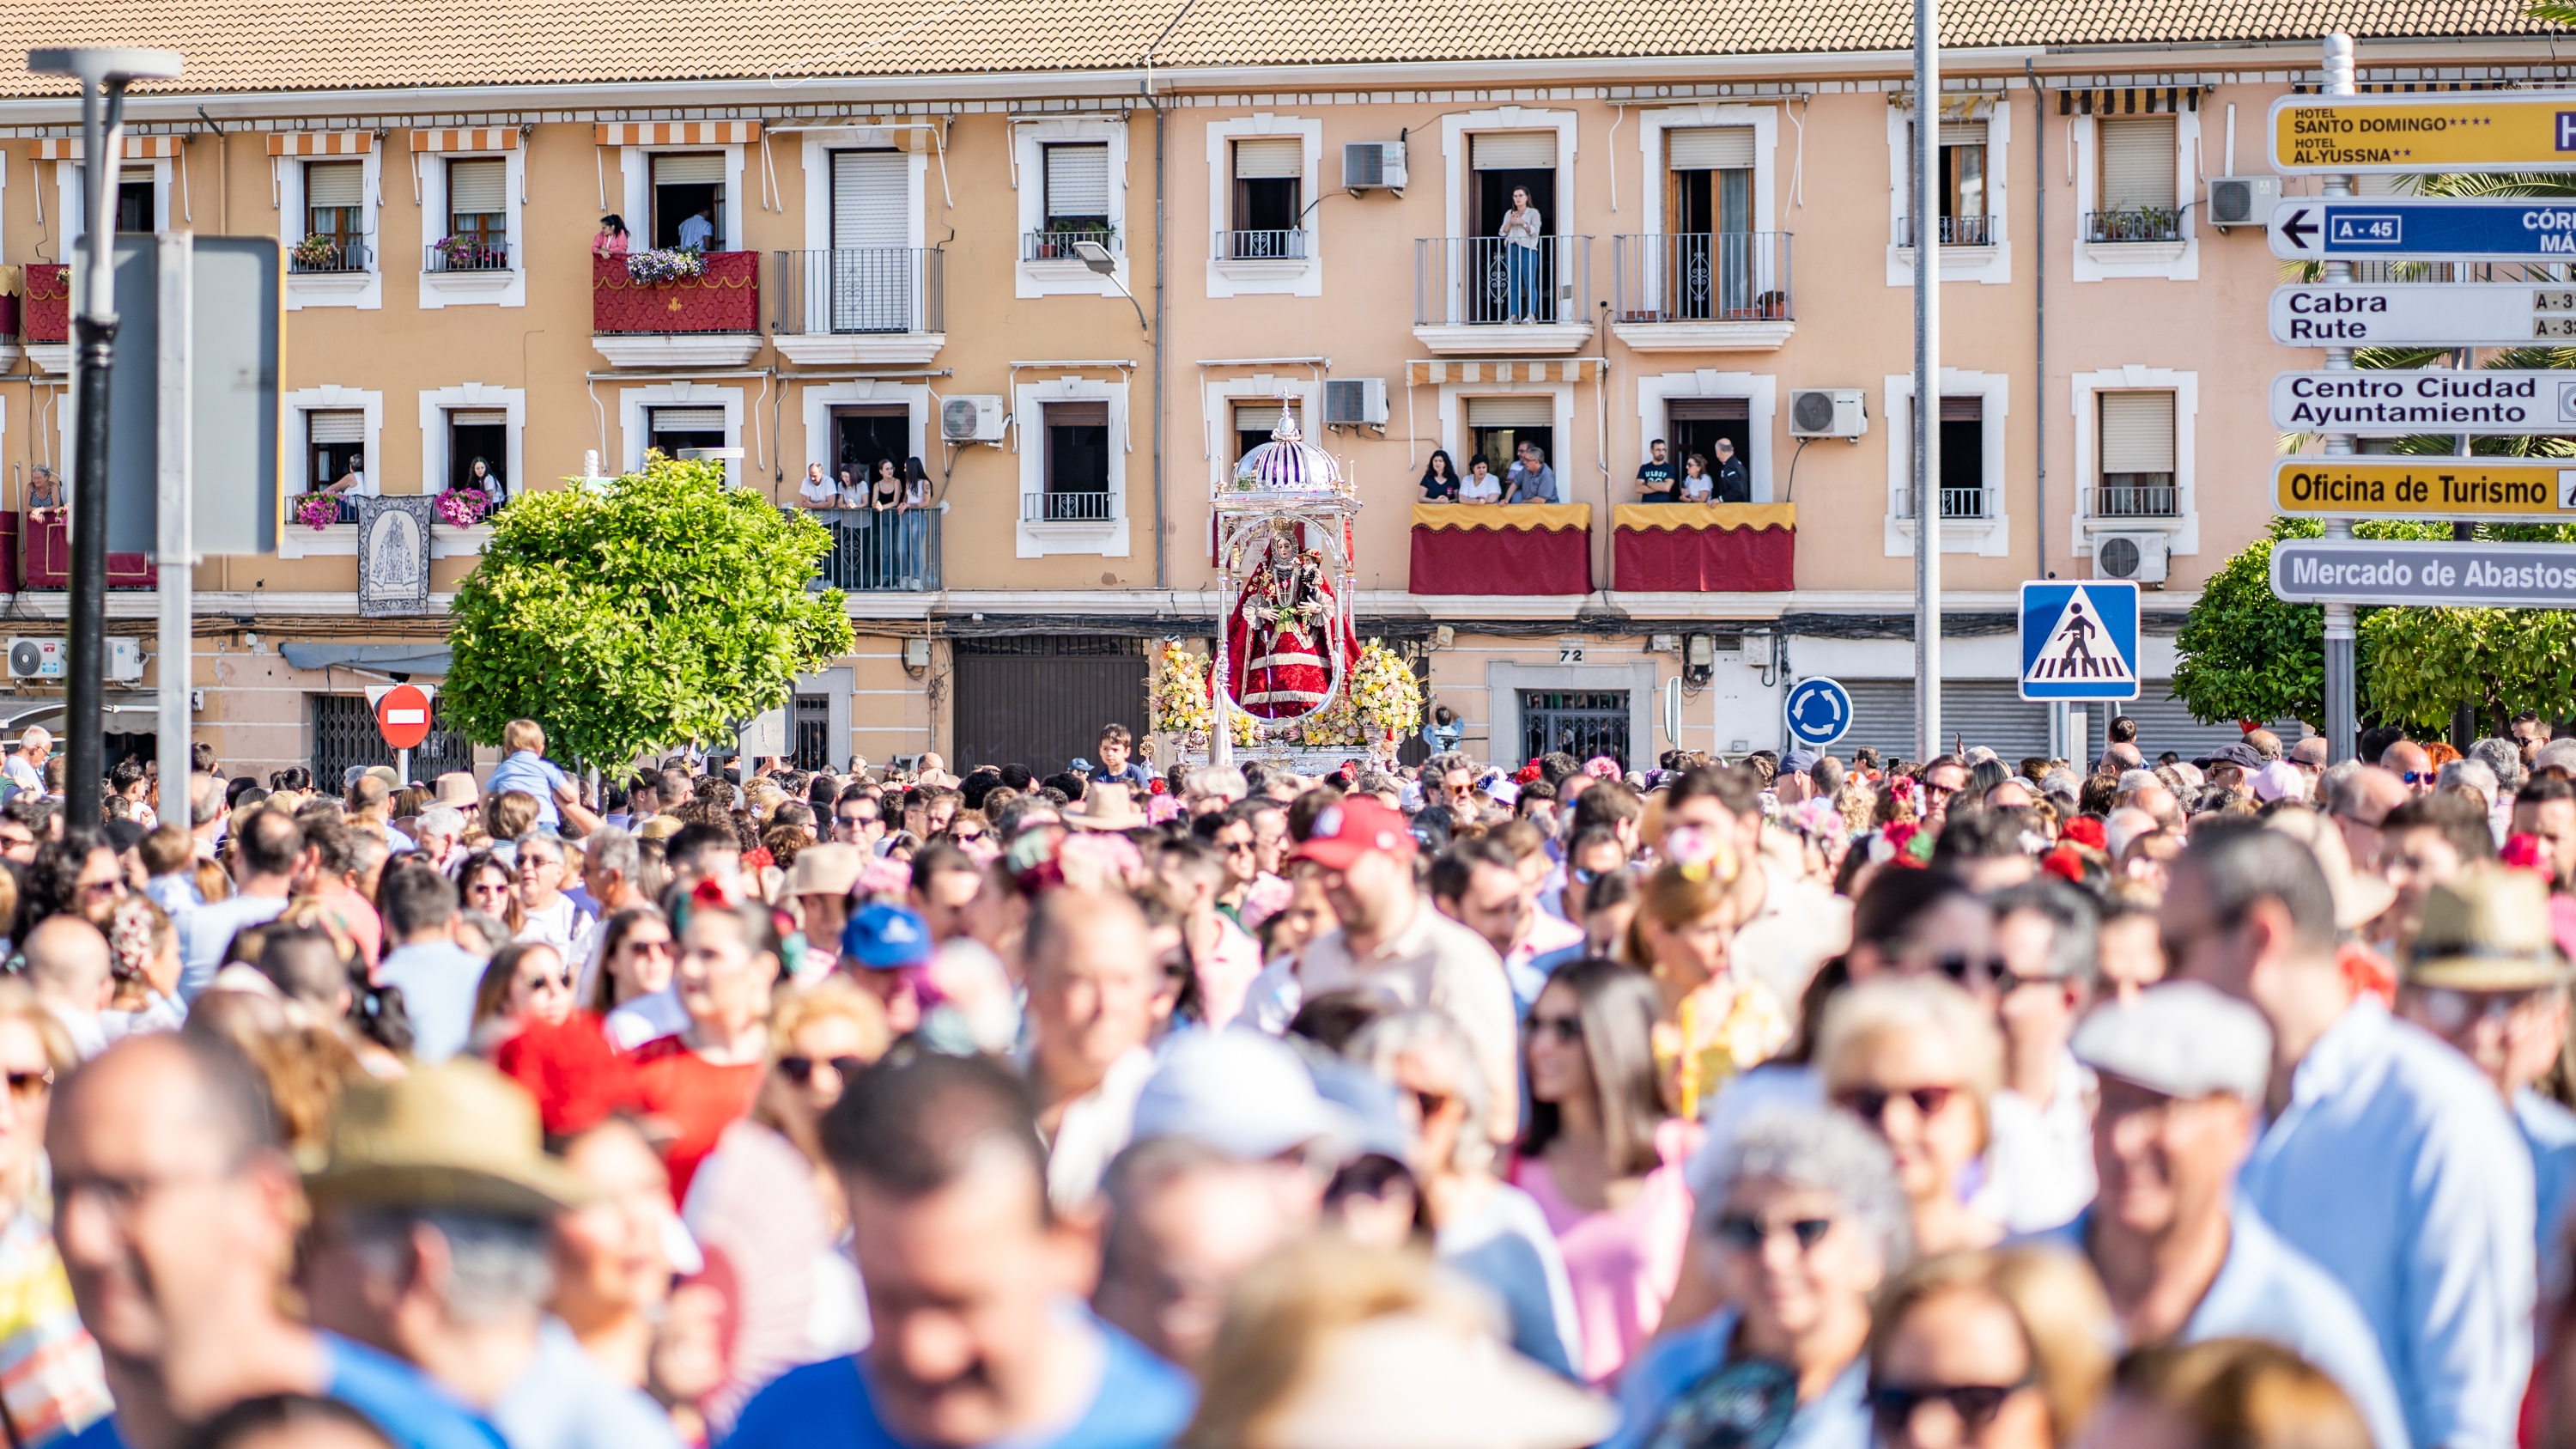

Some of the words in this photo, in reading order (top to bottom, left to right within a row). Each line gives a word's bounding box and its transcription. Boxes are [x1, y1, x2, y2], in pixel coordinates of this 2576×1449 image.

[2295, 109, 2336, 119] HOTEL
[2294, 119, 2354, 133] SANTO
[2360, 118, 2446, 132] DOMINGO
[2295, 138, 2336, 148] HOTEL
[2293, 149, 2391, 163] AL-YUSSNA
[2523, 208, 2576, 229] CÓR
[2340, 222, 2353, 236] A
[2369, 222, 2392, 236] 45
[2289, 292, 2387, 314] Cabra
[2536, 293, 2548, 309] A
[2290, 319, 2366, 339] Rute
[2536, 320, 2548, 335] A
[2291, 377, 2403, 398] Centro
[2416, 377, 2536, 398] Ciudad
[2290, 402, 2526, 427] Ayuntamiento
[2291, 472, 2385, 502] Oficina
[2395, 475, 2428, 502] de
[2439, 475, 2547, 504] Turismo
[2293, 557, 2412, 586] Mercado
[2421, 559, 2456, 587] de
[2464, 560, 2576, 589] Abastos
[1560, 649, 1583, 662] 72
